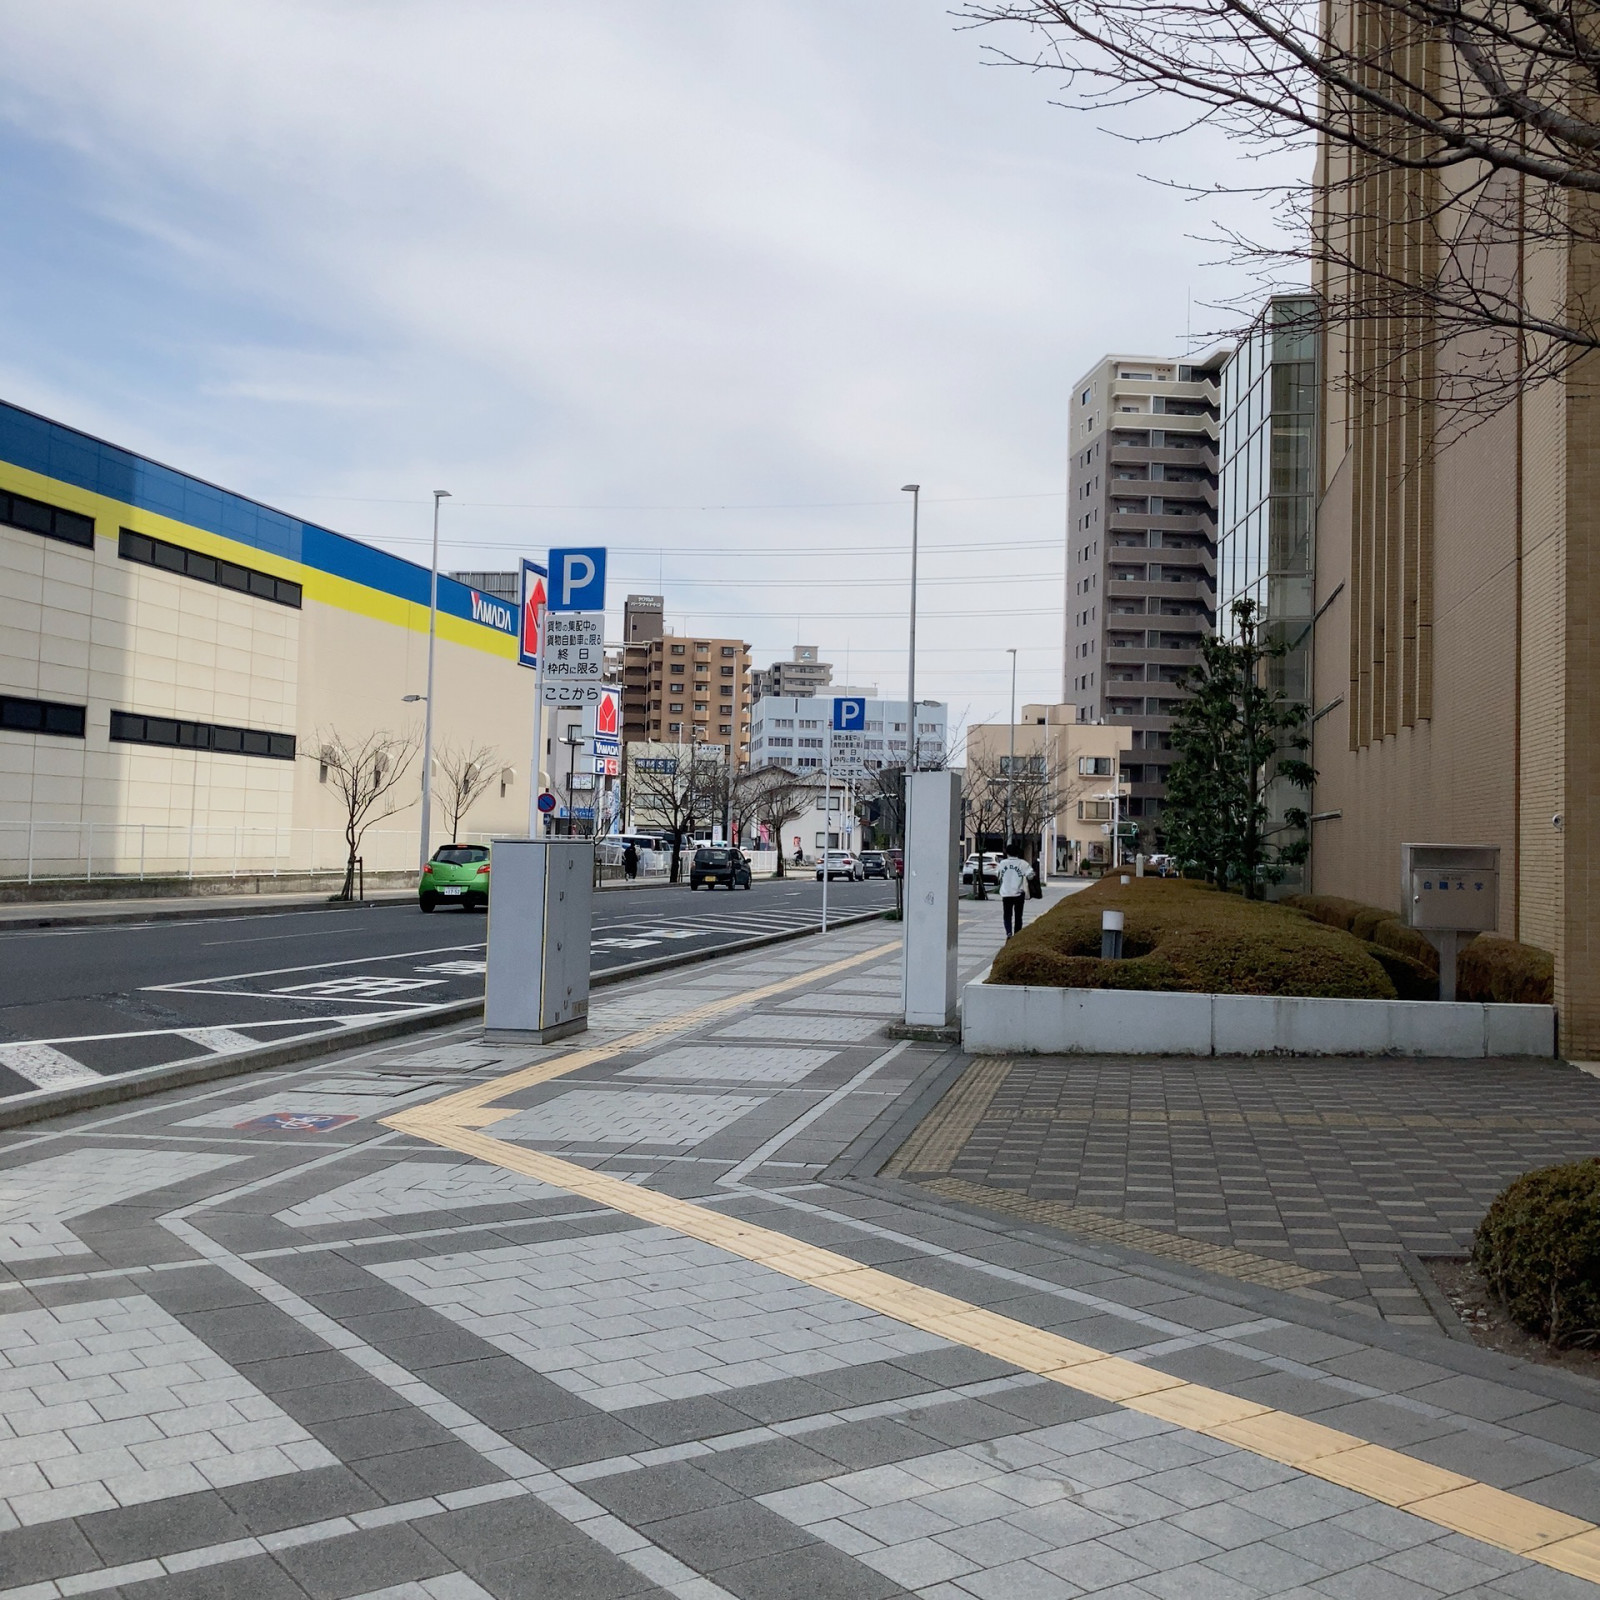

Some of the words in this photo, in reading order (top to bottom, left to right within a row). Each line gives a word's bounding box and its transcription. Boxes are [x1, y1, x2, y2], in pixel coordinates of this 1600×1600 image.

[562, 554, 596, 605] P
[470, 591, 512, 632] YAMADA
[547, 620, 597, 632] 貨物の集配中の
[546, 634, 602, 647] 貨物自動車に限る
[547, 662, 599, 675] 枠内に限る
[545, 687, 599, 701] ここから
[841, 701, 860, 728] P
[595, 741, 619, 756] YAMADA
[596, 759, 604, 772] P
[832, 769, 863, 777] ここまで
